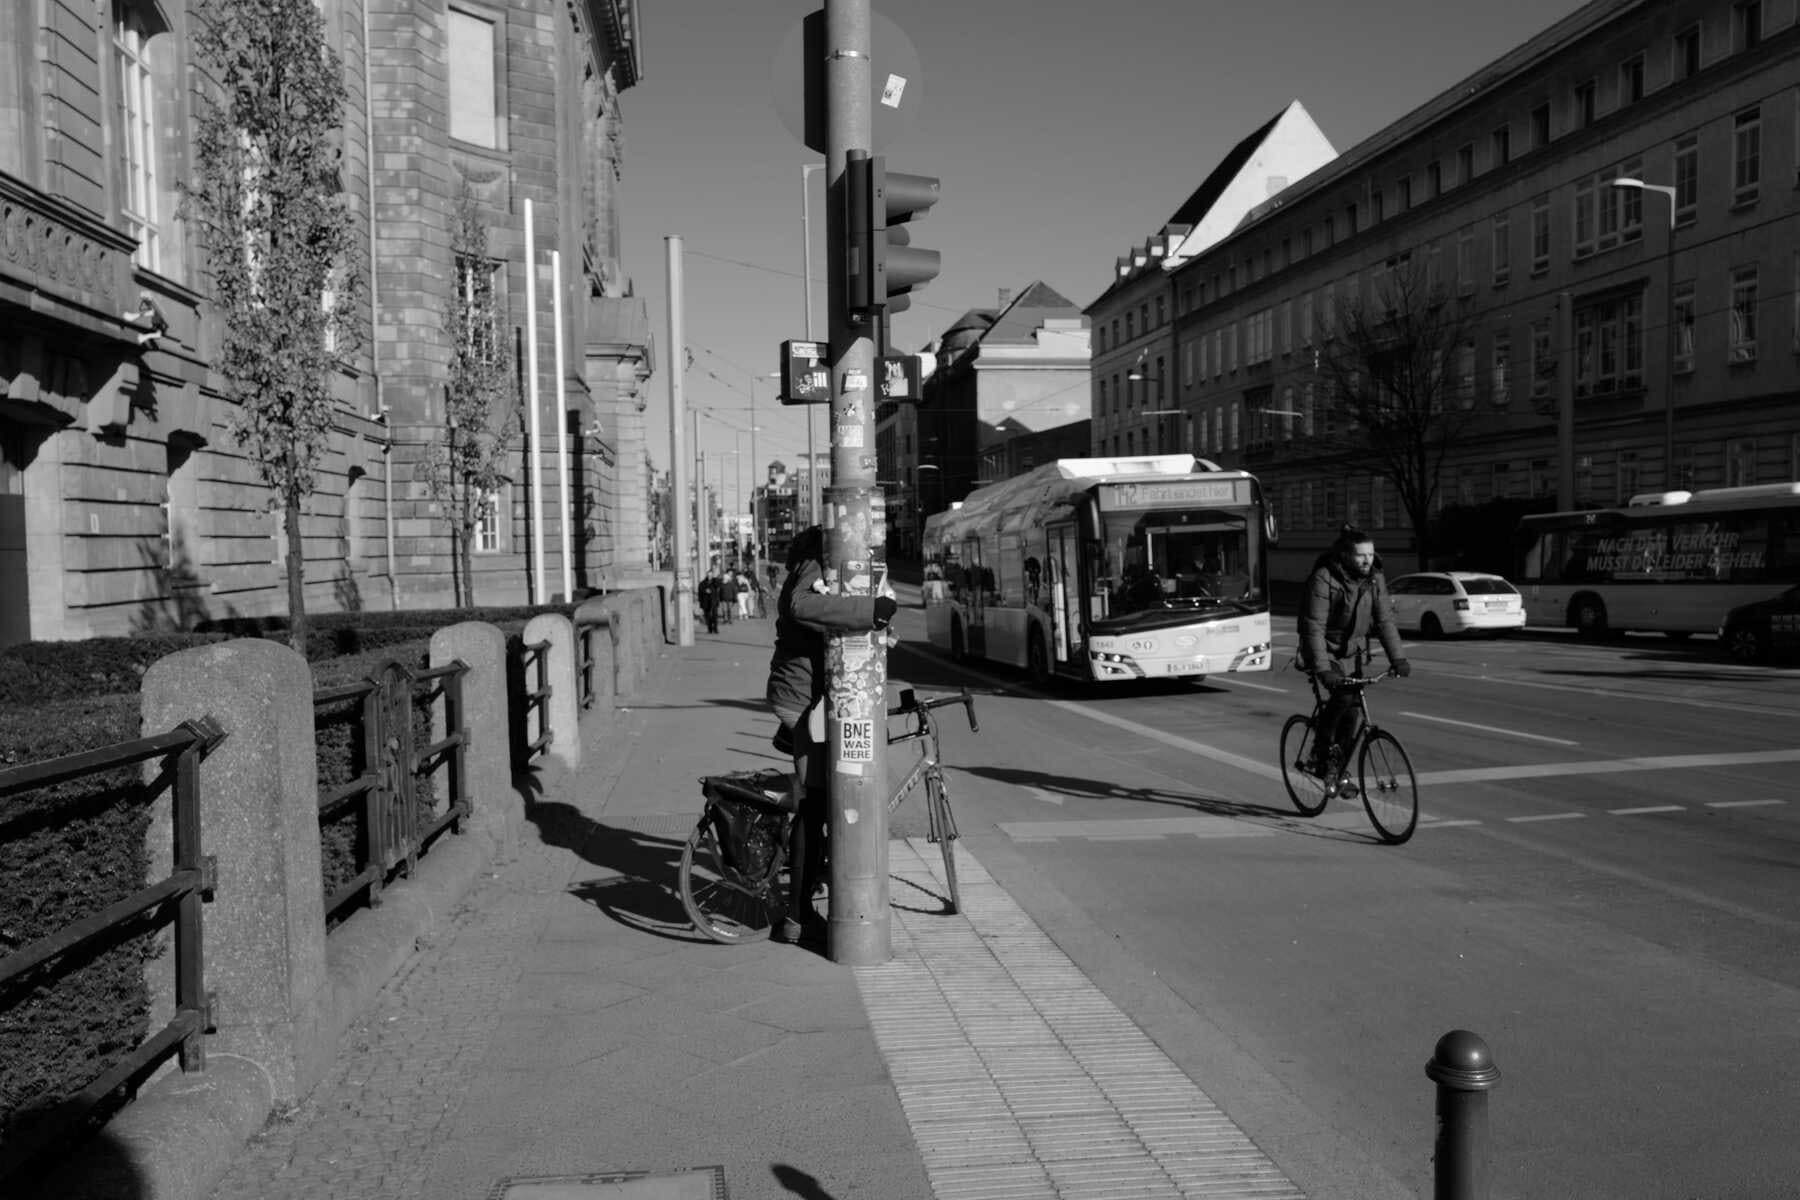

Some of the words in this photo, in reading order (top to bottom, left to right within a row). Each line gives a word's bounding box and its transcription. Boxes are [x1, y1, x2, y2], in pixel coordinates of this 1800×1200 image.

[1655, 553, 1704, 569] LEIDER
[843, 722, 871, 739] BNE
[844, 740, 871, 749] WAS
[843, 750, 871, 759] HERE
